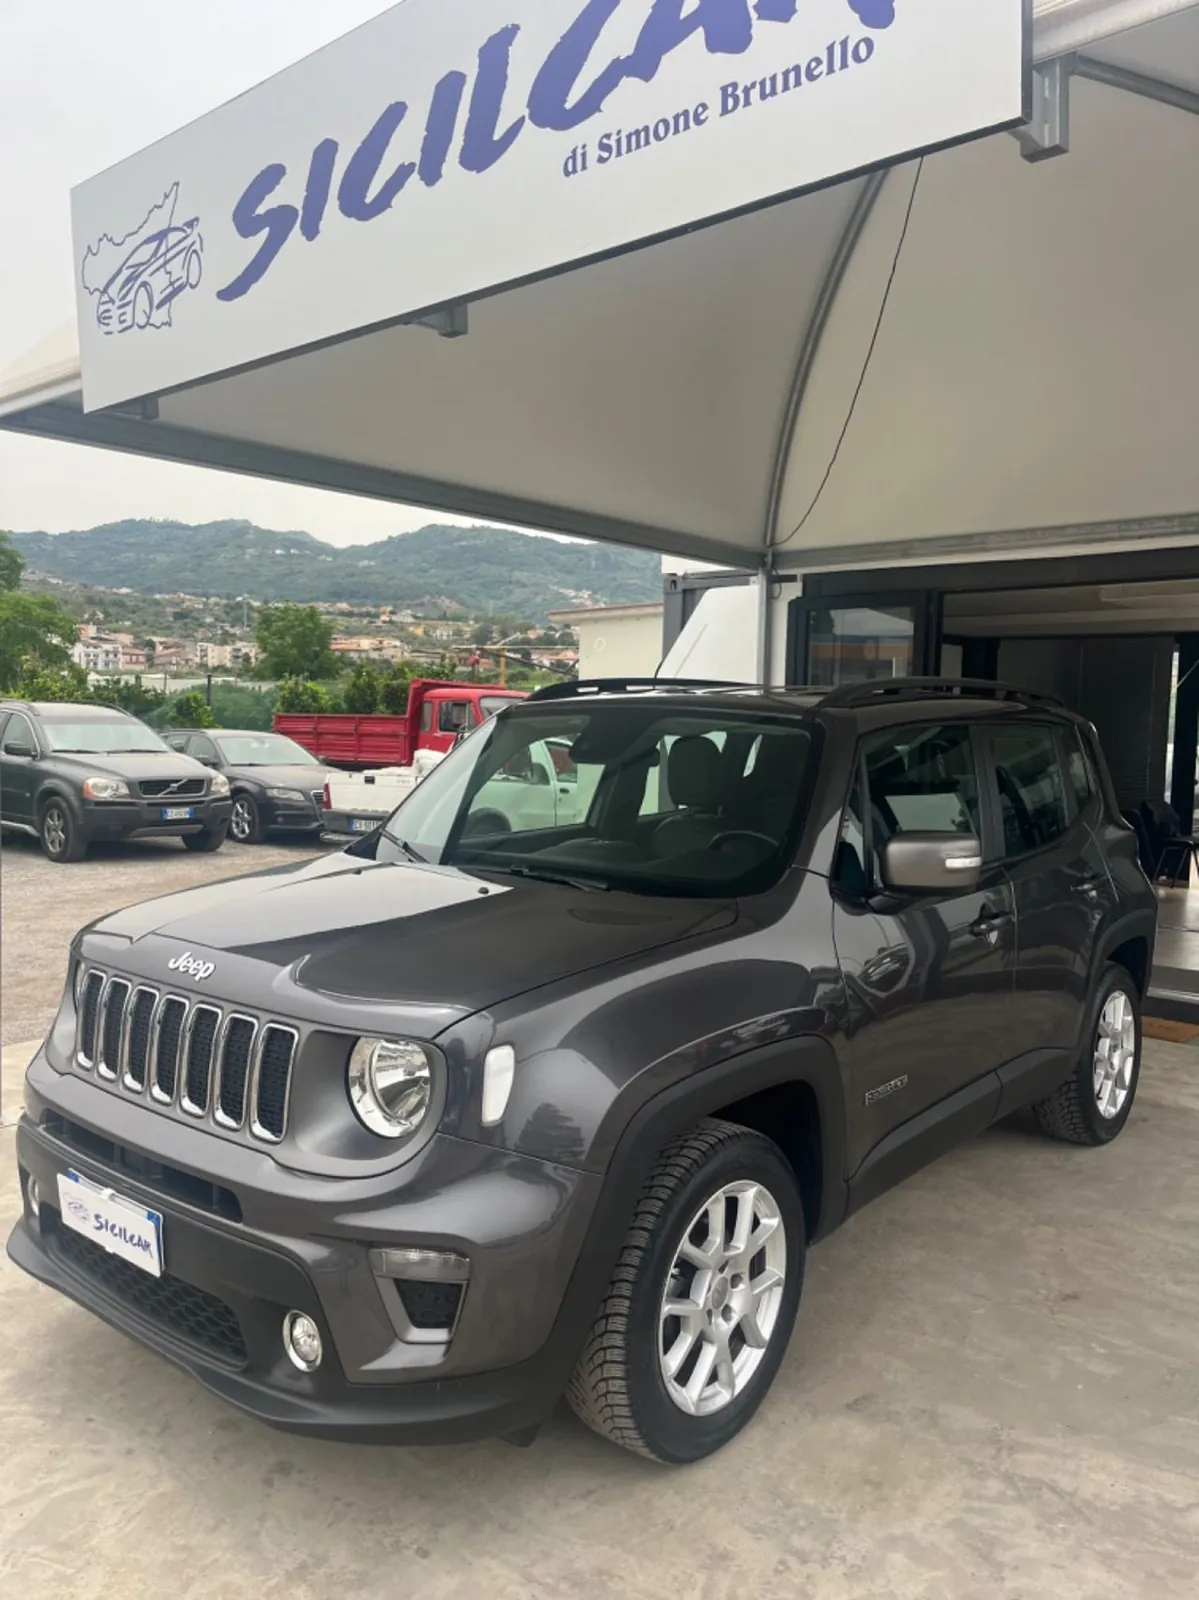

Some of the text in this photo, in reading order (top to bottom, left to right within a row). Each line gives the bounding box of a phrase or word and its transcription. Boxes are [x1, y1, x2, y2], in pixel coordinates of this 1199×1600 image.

[217, 0, 896, 301] SICILCA
[563, 36, 875, 178] di Simone Brunello
[168, 952, 215, 982] Jeep
